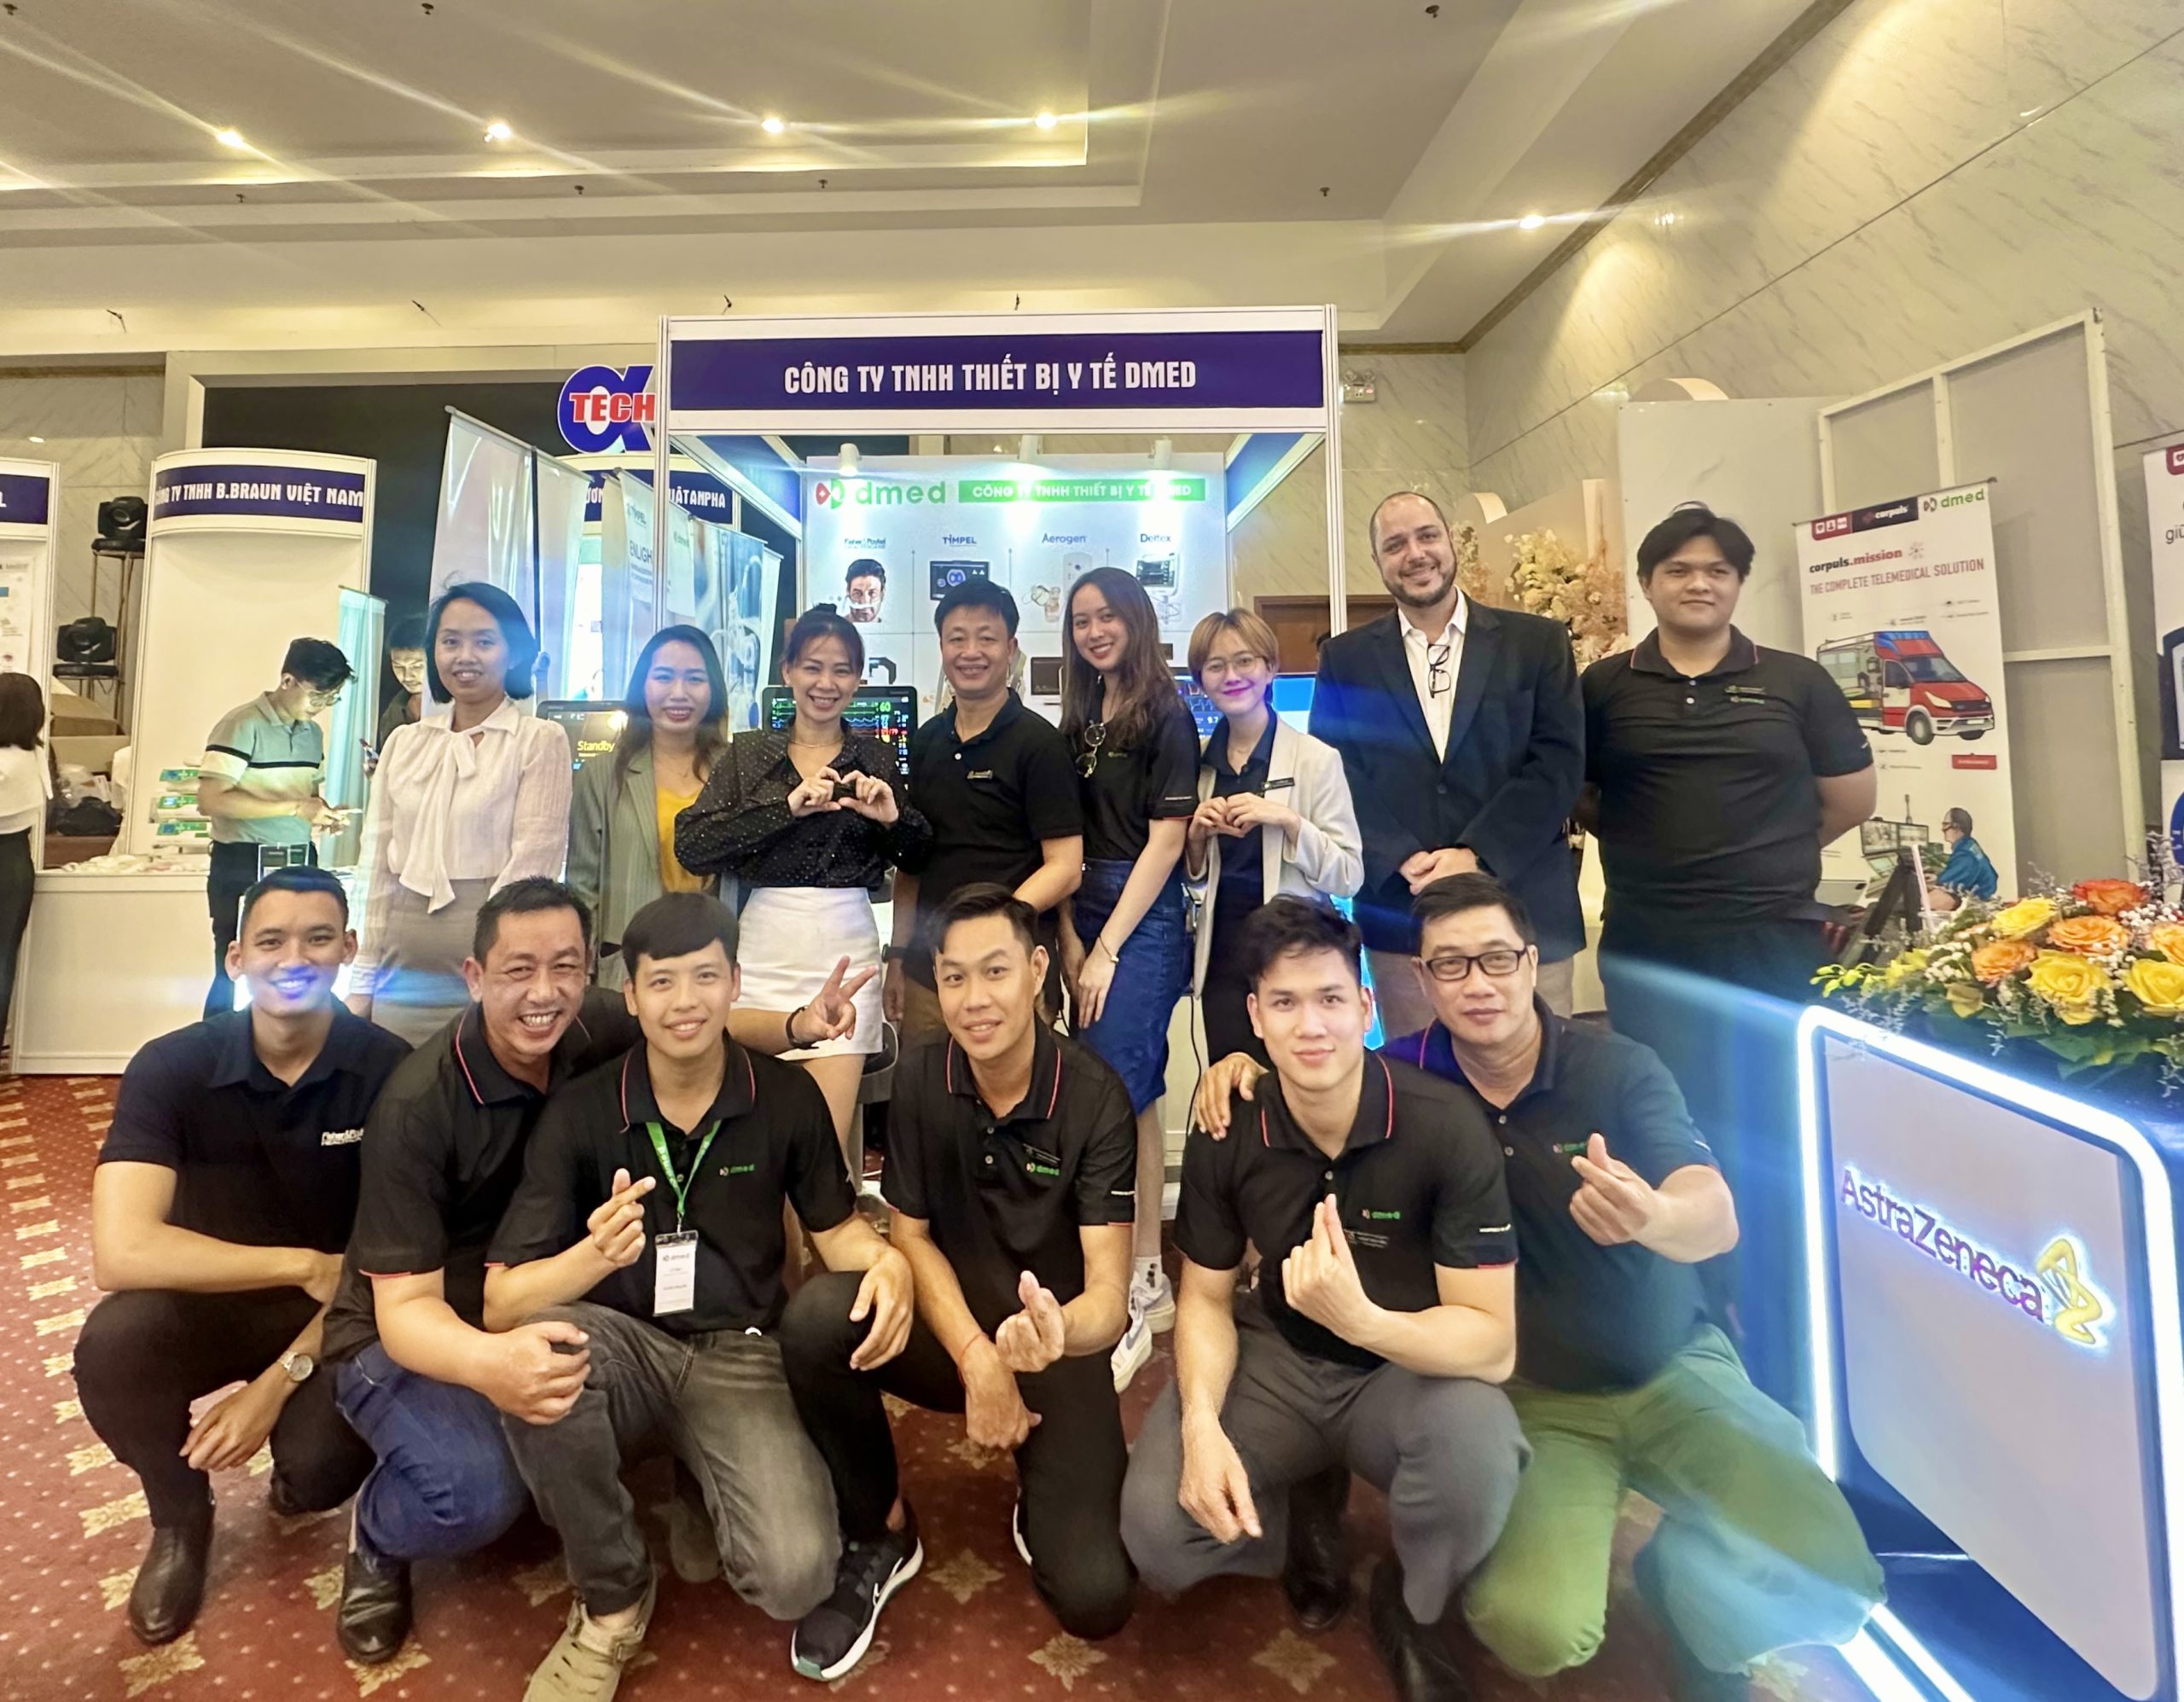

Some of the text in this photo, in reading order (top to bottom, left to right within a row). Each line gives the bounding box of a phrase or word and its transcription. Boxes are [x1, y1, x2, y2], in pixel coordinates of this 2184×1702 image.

[784, 351, 1196, 395] CÔNG TY TNHH THIẾT BỊ Y TẾ DMED
[570, 392, 655, 422] TECH
[171, 485, 182, 502] TY
[183, 483, 212, 500] TNHH
[216, 482, 282, 501] B.BRAUN
[287, 482, 322, 505] VIỆT
[326, 487, 363, 507] NAM
[856, 480, 946, 505] dmed
[973, 484, 1014, 497] CÔNG
[1036, 485, 1070, 497] TNHH
[1074, 481, 1107, 497] THIẾT
[1126, 485, 1135, 496] Y
[1940, 488, 1986, 509] dmed
[1874, 505, 1909, 520] corpuls
[1041, 532, 1085, 545] Aerogen
[1809, 549, 1902, 573] corpuls.mission
[1810, 558, 1985, 595] THE COMPLETE TELEMEDICAL SOLUTION
[577, 740, 615, 752] Standby
[1840, 1168, 2045, 1324] AstraZeneca
